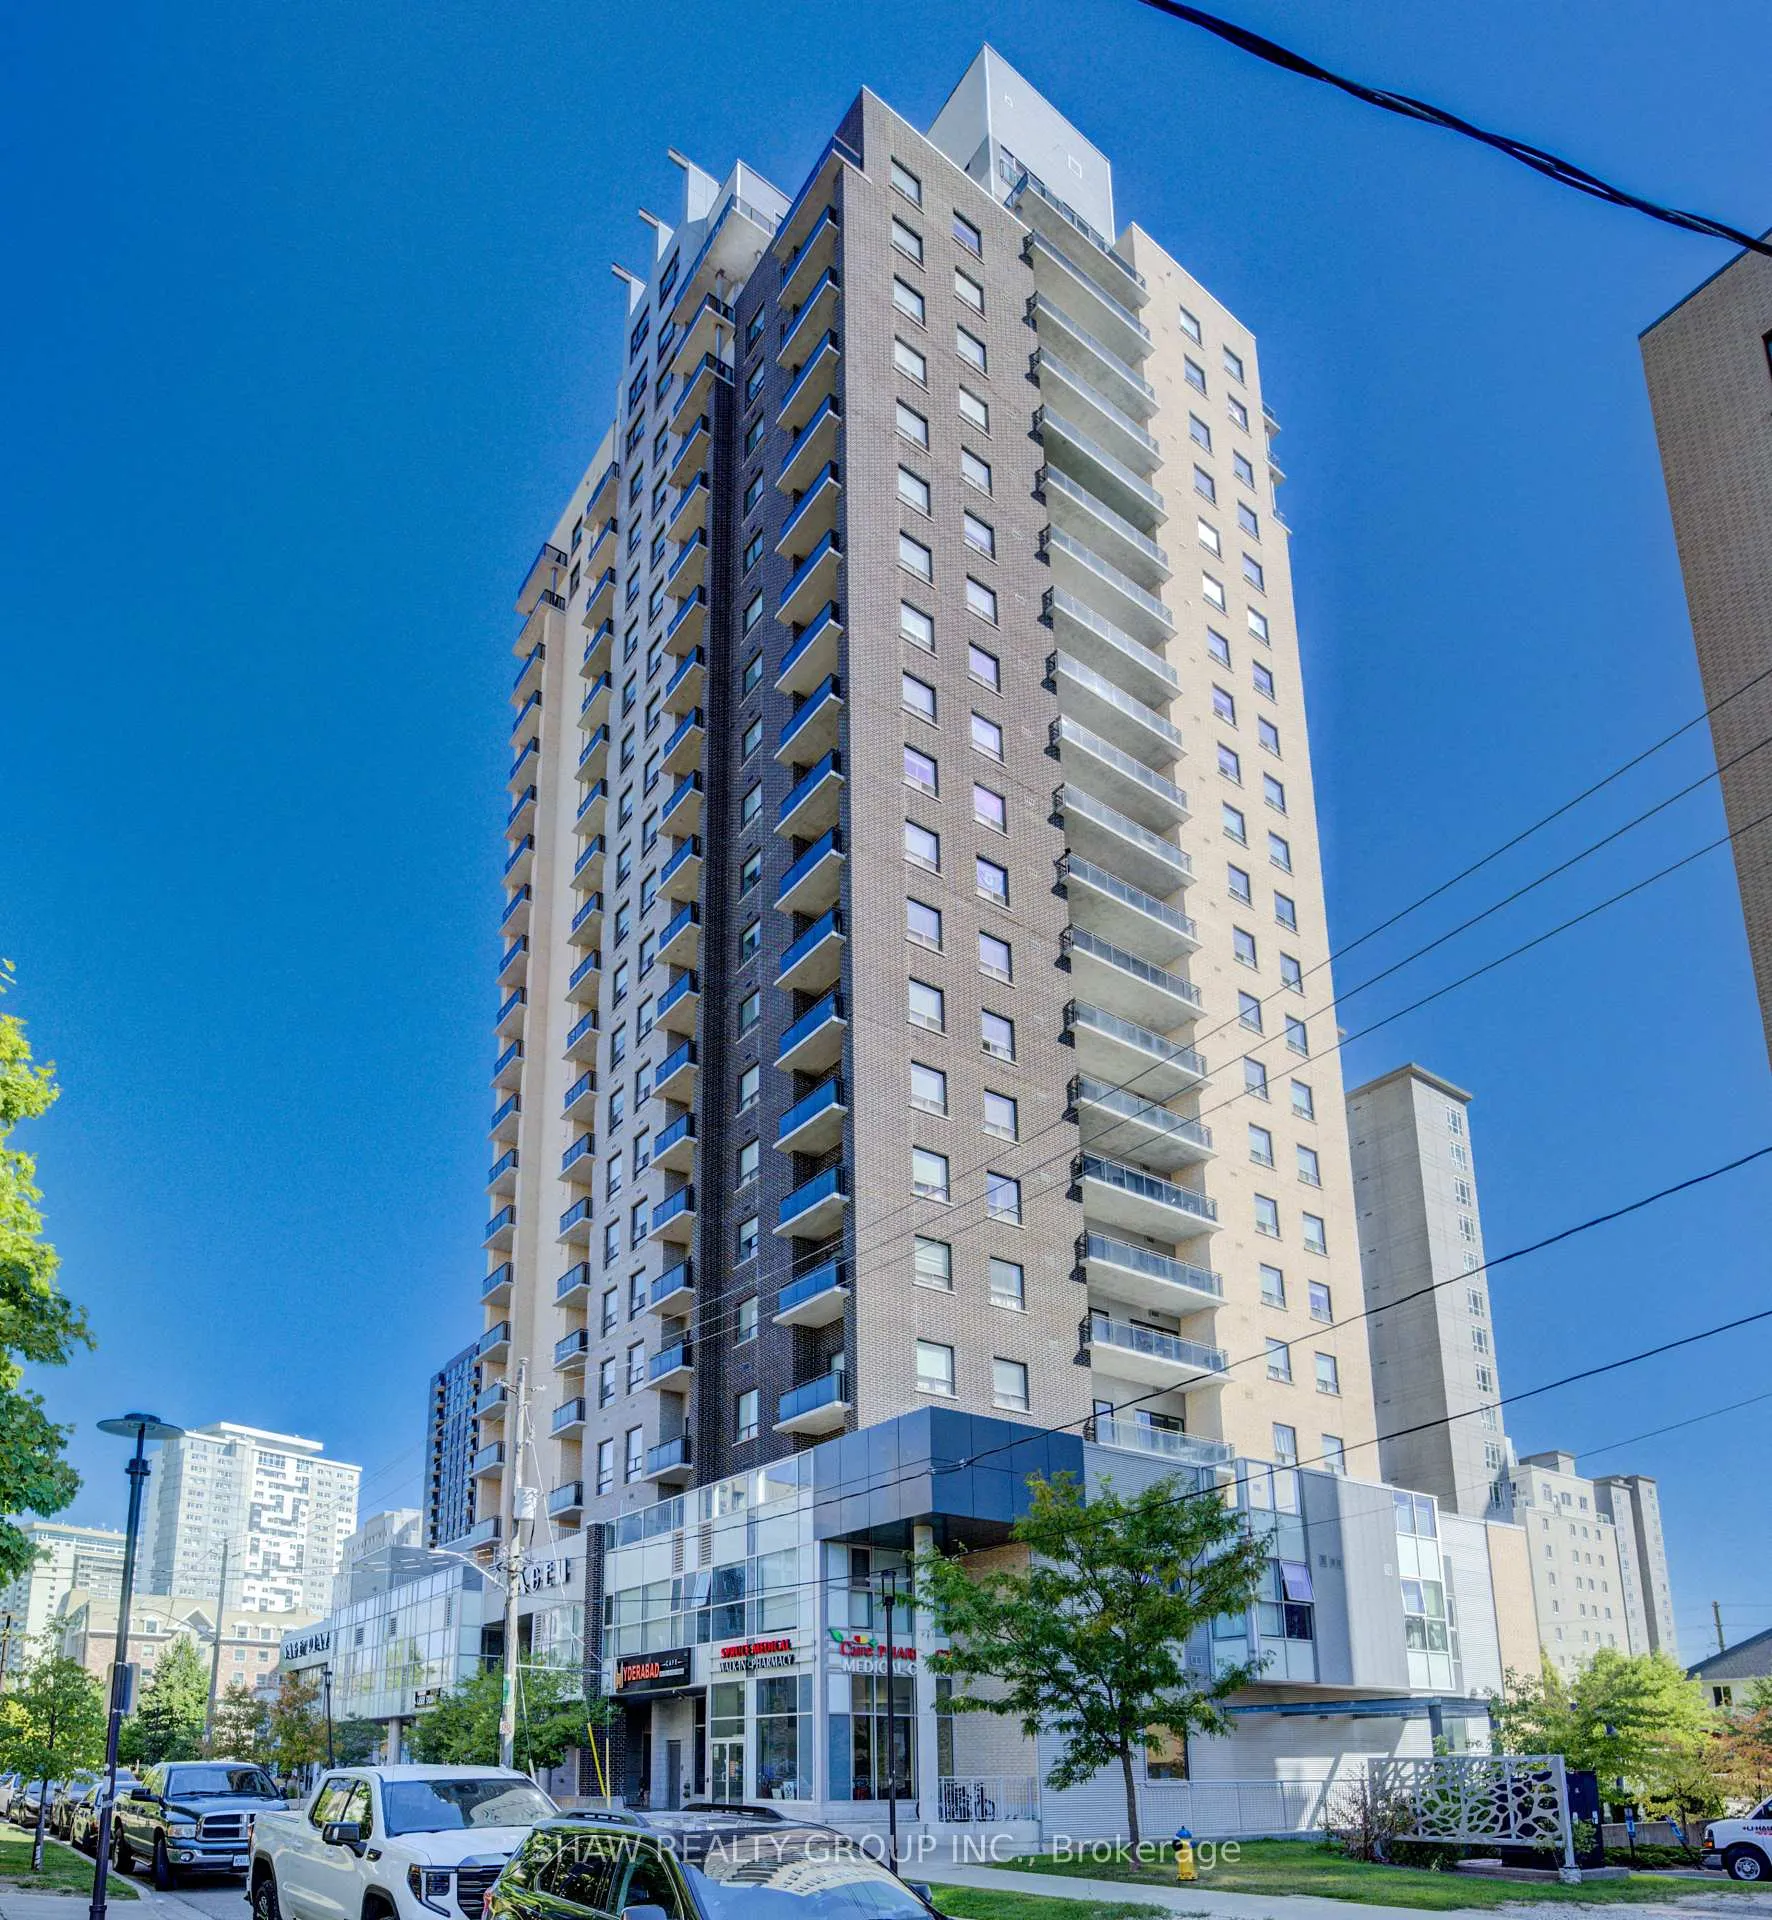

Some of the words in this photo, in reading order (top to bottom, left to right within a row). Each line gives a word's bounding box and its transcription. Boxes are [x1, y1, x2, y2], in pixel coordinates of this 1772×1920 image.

[518, 1561, 556, 1594] AGE
[840, 1640, 874, 1657] Care
[751, 1654, 795, 1670] PHARMACY
